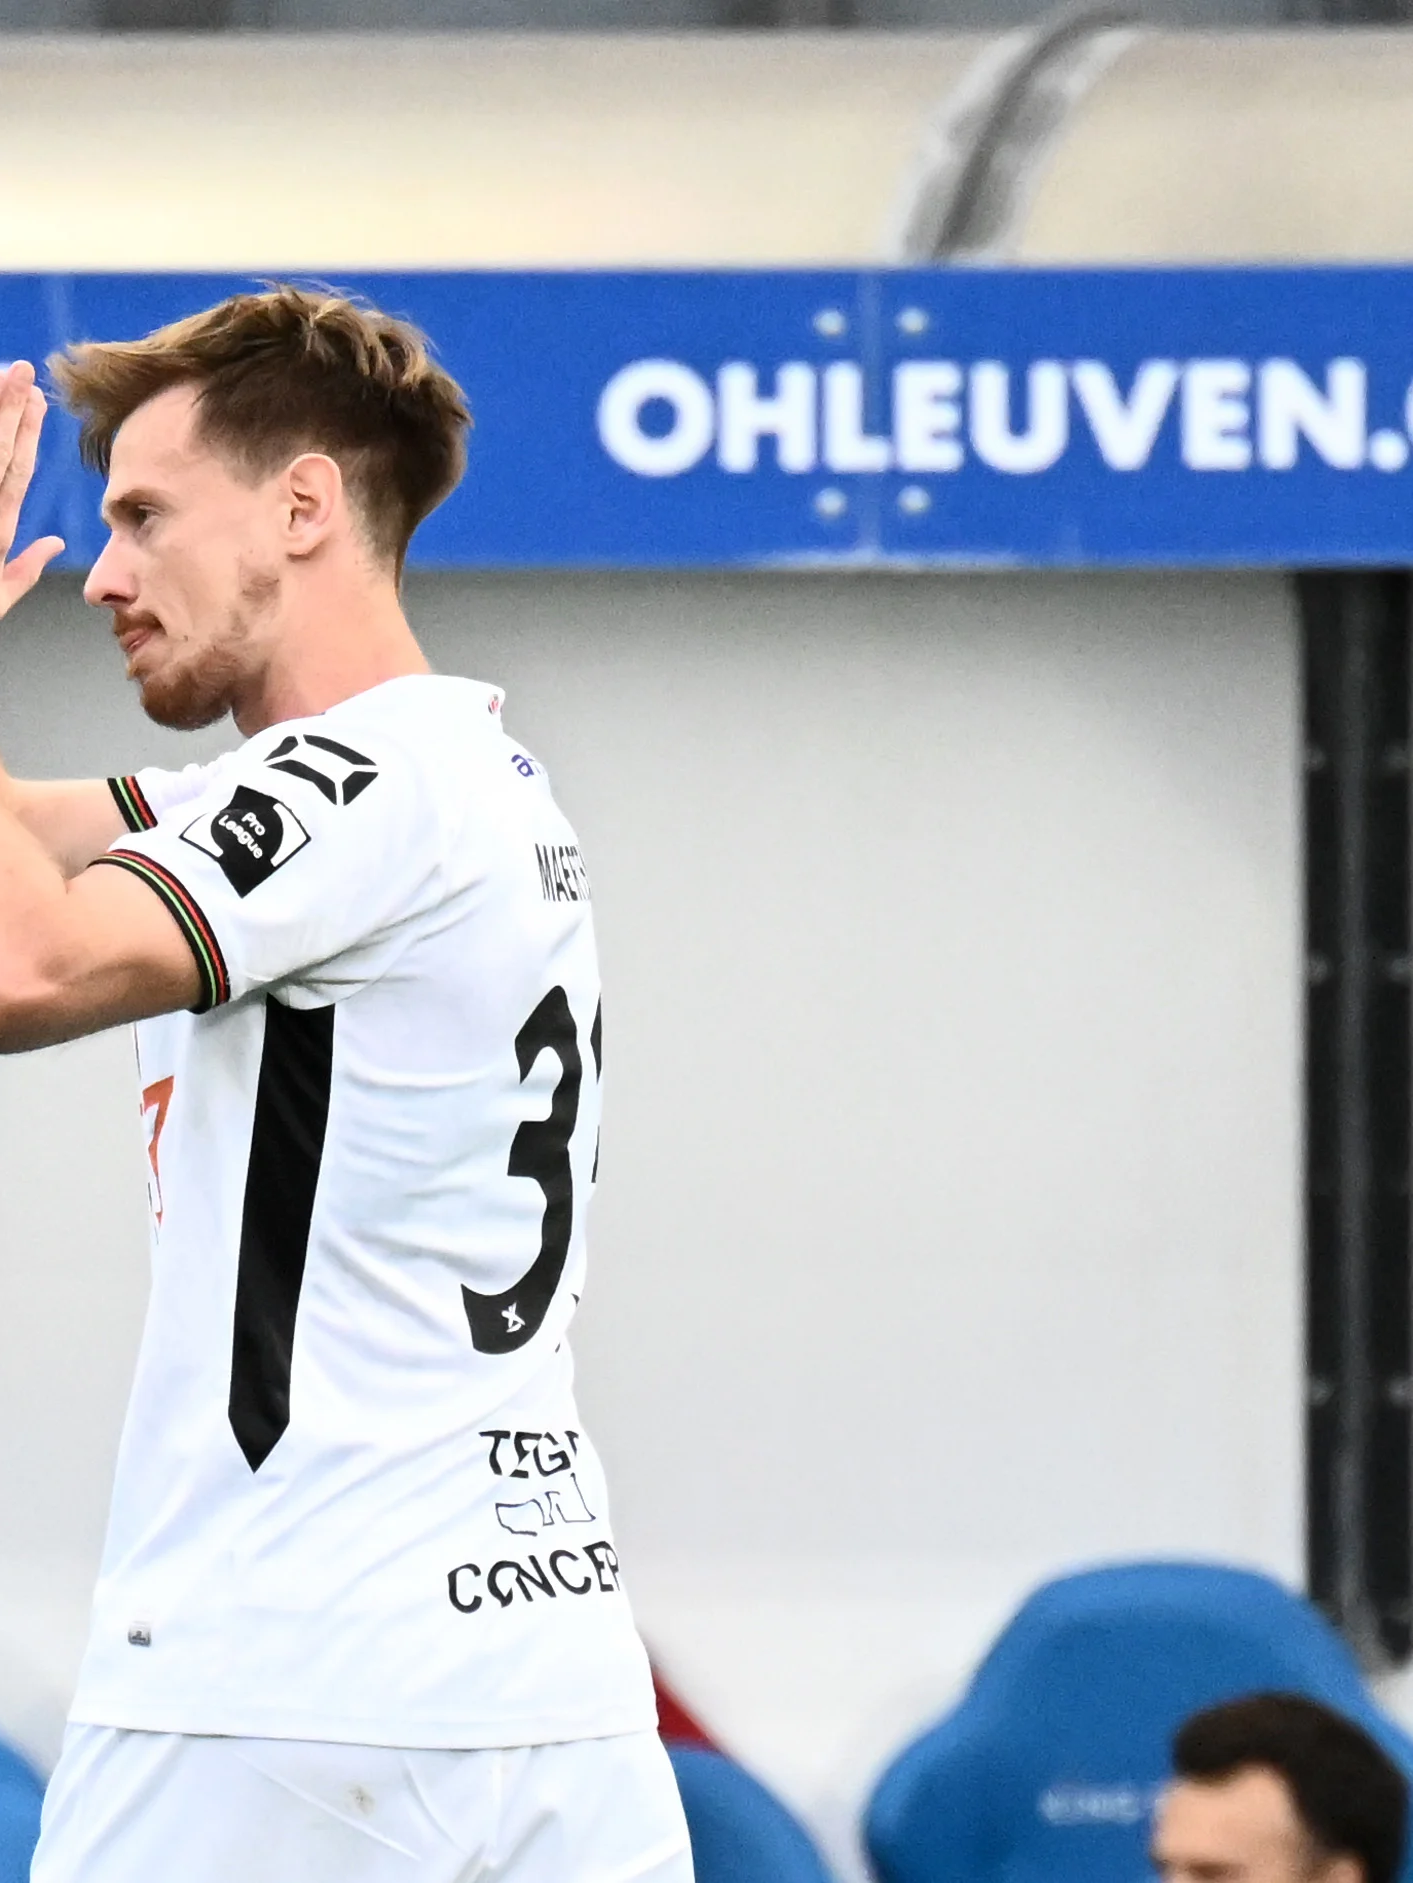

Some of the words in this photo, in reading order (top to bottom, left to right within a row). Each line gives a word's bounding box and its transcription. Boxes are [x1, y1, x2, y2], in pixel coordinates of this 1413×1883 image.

[596, 355, 1413, 477] OHLEUVEN.
[218, 814, 264, 859] League
[241, 811, 266, 836] Pro
[461, 985, 602, 1355] 3
